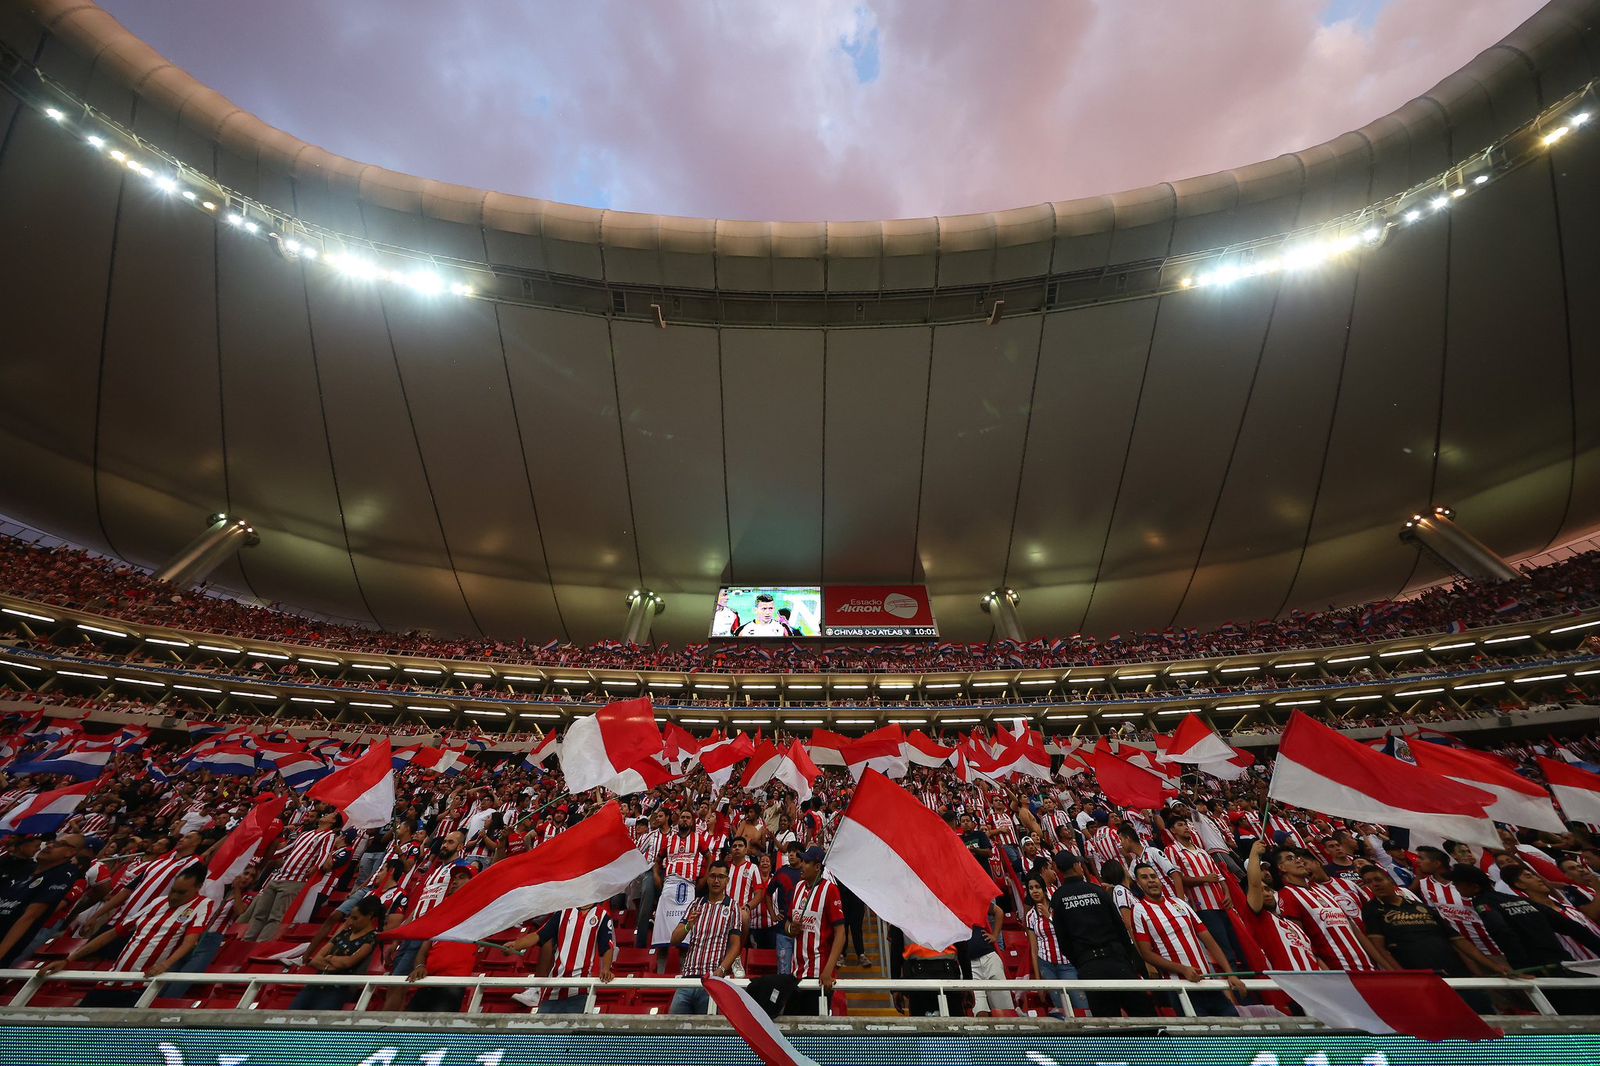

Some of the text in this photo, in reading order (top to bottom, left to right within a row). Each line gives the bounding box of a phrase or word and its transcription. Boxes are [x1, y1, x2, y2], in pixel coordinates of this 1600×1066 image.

[850, 598, 882, 606] Estadio
[836, 603, 882, 612] AKRON
[834, 628, 864, 636] CHIVAS
[865, 628, 877, 636] 0-0
[877, 628, 903, 636] ATLAS
[1063, 897, 1101, 910] ZAPOPAN
